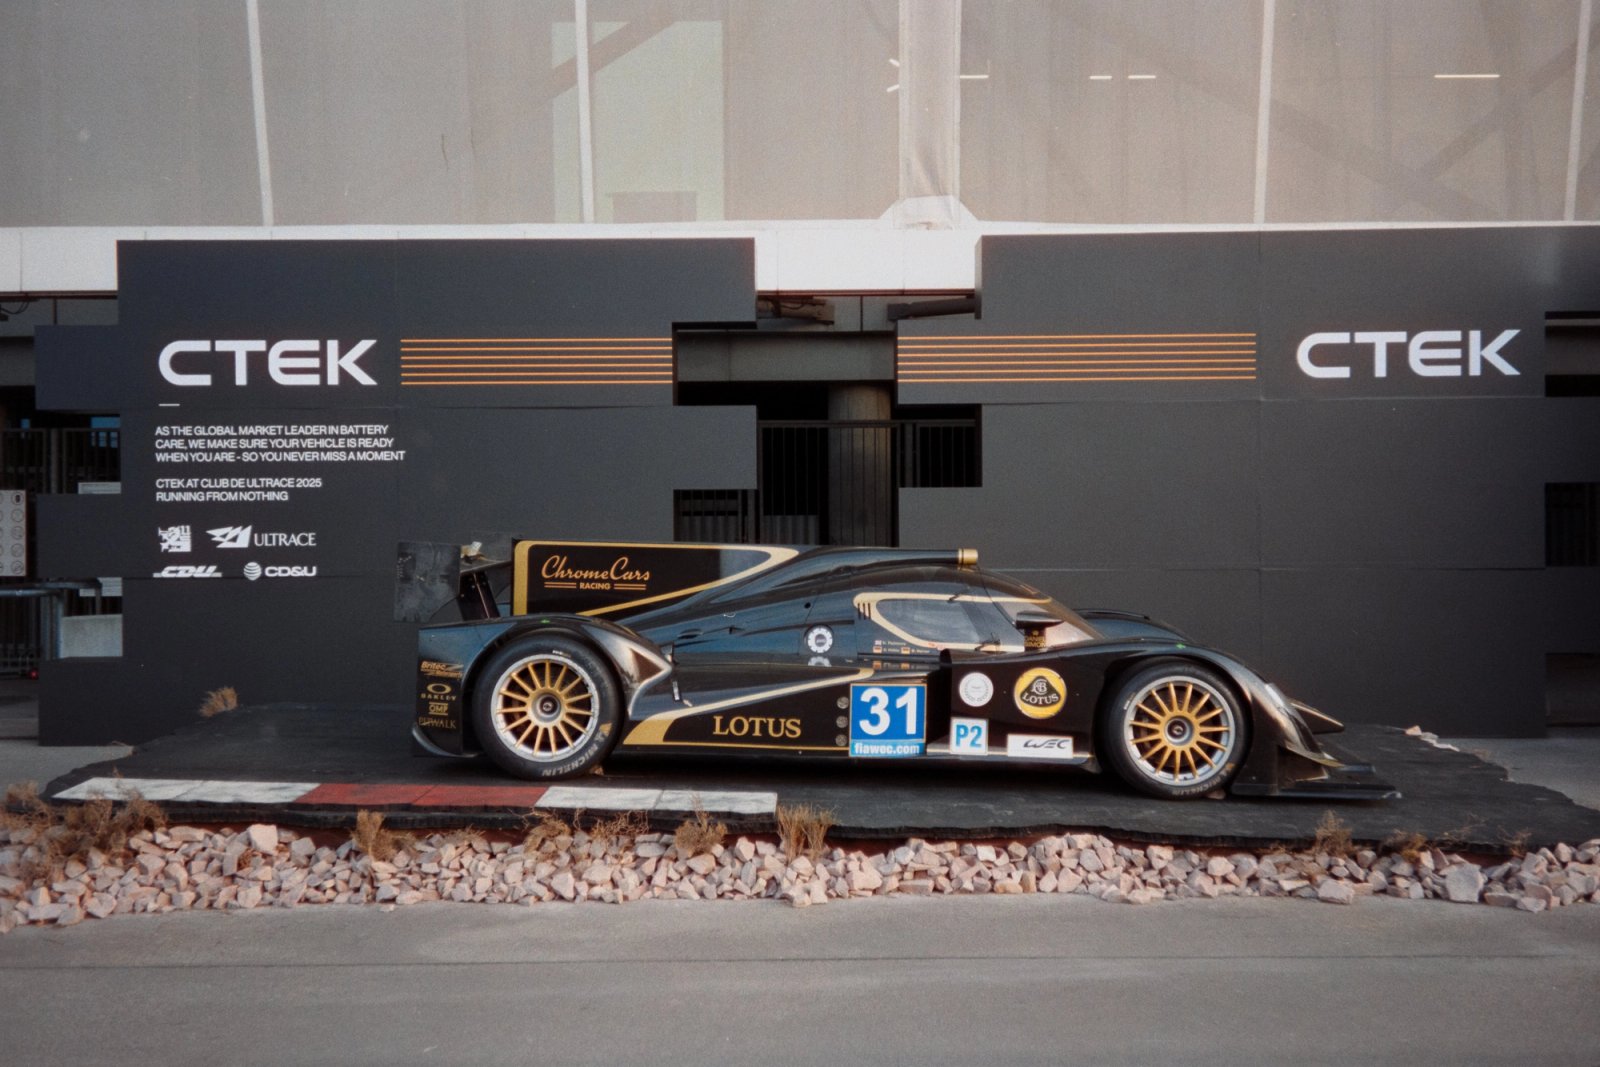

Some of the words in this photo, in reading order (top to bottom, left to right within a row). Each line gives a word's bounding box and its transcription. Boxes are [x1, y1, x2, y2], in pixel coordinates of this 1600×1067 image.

[1296, 329, 1521, 378] CTEK
[158, 339, 378, 386] CTEK
[155, 426, 170, 436] AS
[170, 426, 193, 436] THE
[194, 425, 237, 436] GLOBAL
[238, 425, 283, 436] MARKET
[284, 425, 327, 435] LEADER
[328, 425, 339, 435] IN
[340, 425, 388, 435] BATTERY
[155, 439, 187, 450] CARE,
[188, 439, 206, 449] WE
[207, 439, 238, 449] MAKE
[239, 439, 268, 449] SURE
[269, 438, 299, 448] YOUR
[300, 438, 346, 448] VEHICLE
[347, 438, 356, 448] IS
[358, 438, 394, 448] READY
[155, 452, 188, 462] WHEN
[189, 452, 212, 462] YOU
[213, 452, 236, 462] ARE
[241, 452, 259, 462] SO
[259, 452, 282, 461] YOU
[283, 451, 320, 461] NEVER
[320, 451, 346, 461] MISS
[347, 451, 356, 461] A
[356, 450, 406, 461] MOMENT
[155, 478, 185, 489] CTEK
[185, 478, 199, 488] AT
[200, 478, 229, 488] CLUB
[230, 478, 245, 488] DE
[246, 478, 295, 488] ULTRACE
[295, 478, 322, 488] 2025
[155, 492, 205, 502] RUNNING
[206, 491, 238, 501] FROM
[239, 491, 288, 501] NOTHING
[254, 532, 317, 546] ULTRACE
[579, 582, 611, 590] RACING
[421, 693, 457, 701] OAKLEY
[1021, 692, 1059, 705] LOTUS
[428, 704, 448, 713] OMP
[858, 687, 917, 736] 31
[712, 716, 802, 738] LOTUS
[955, 724, 983, 748] P2
[854, 743, 920, 755] fiawec.com
[1023, 738, 1070, 750] WEC
[542, 743, 598, 776] MICHELIN
